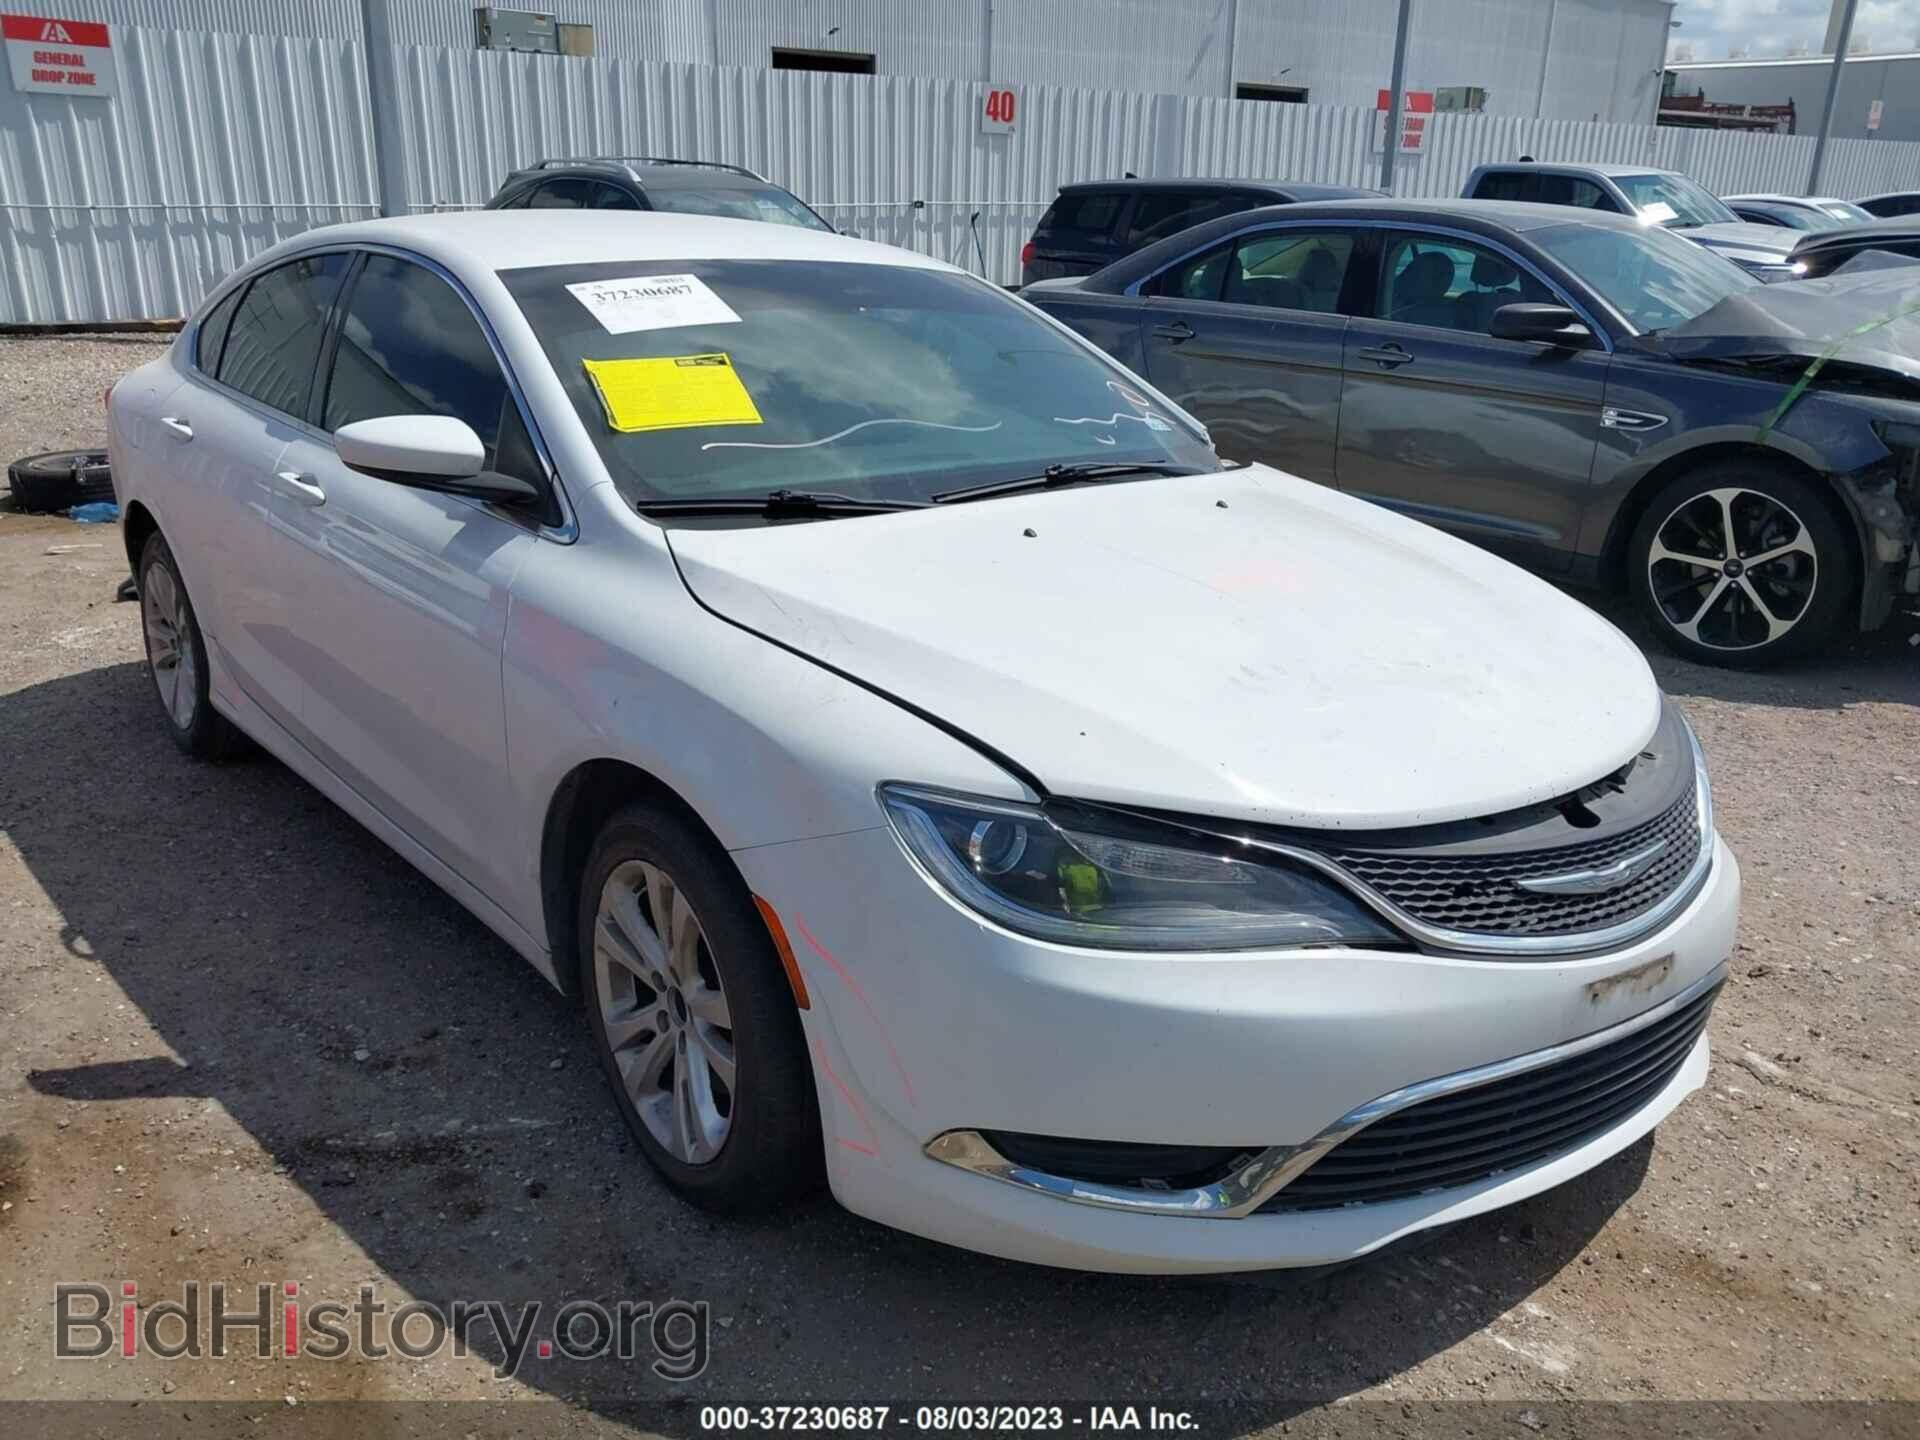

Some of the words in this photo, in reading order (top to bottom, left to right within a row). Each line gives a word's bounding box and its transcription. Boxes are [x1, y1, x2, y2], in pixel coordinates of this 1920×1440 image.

[33, 50, 86, 67] GENERAL
[32, 68, 65, 83] DROP
[66, 71, 97, 86] ZONE
[986, 90, 1015, 123] 40
[591, 284, 693, 303] 37230687
